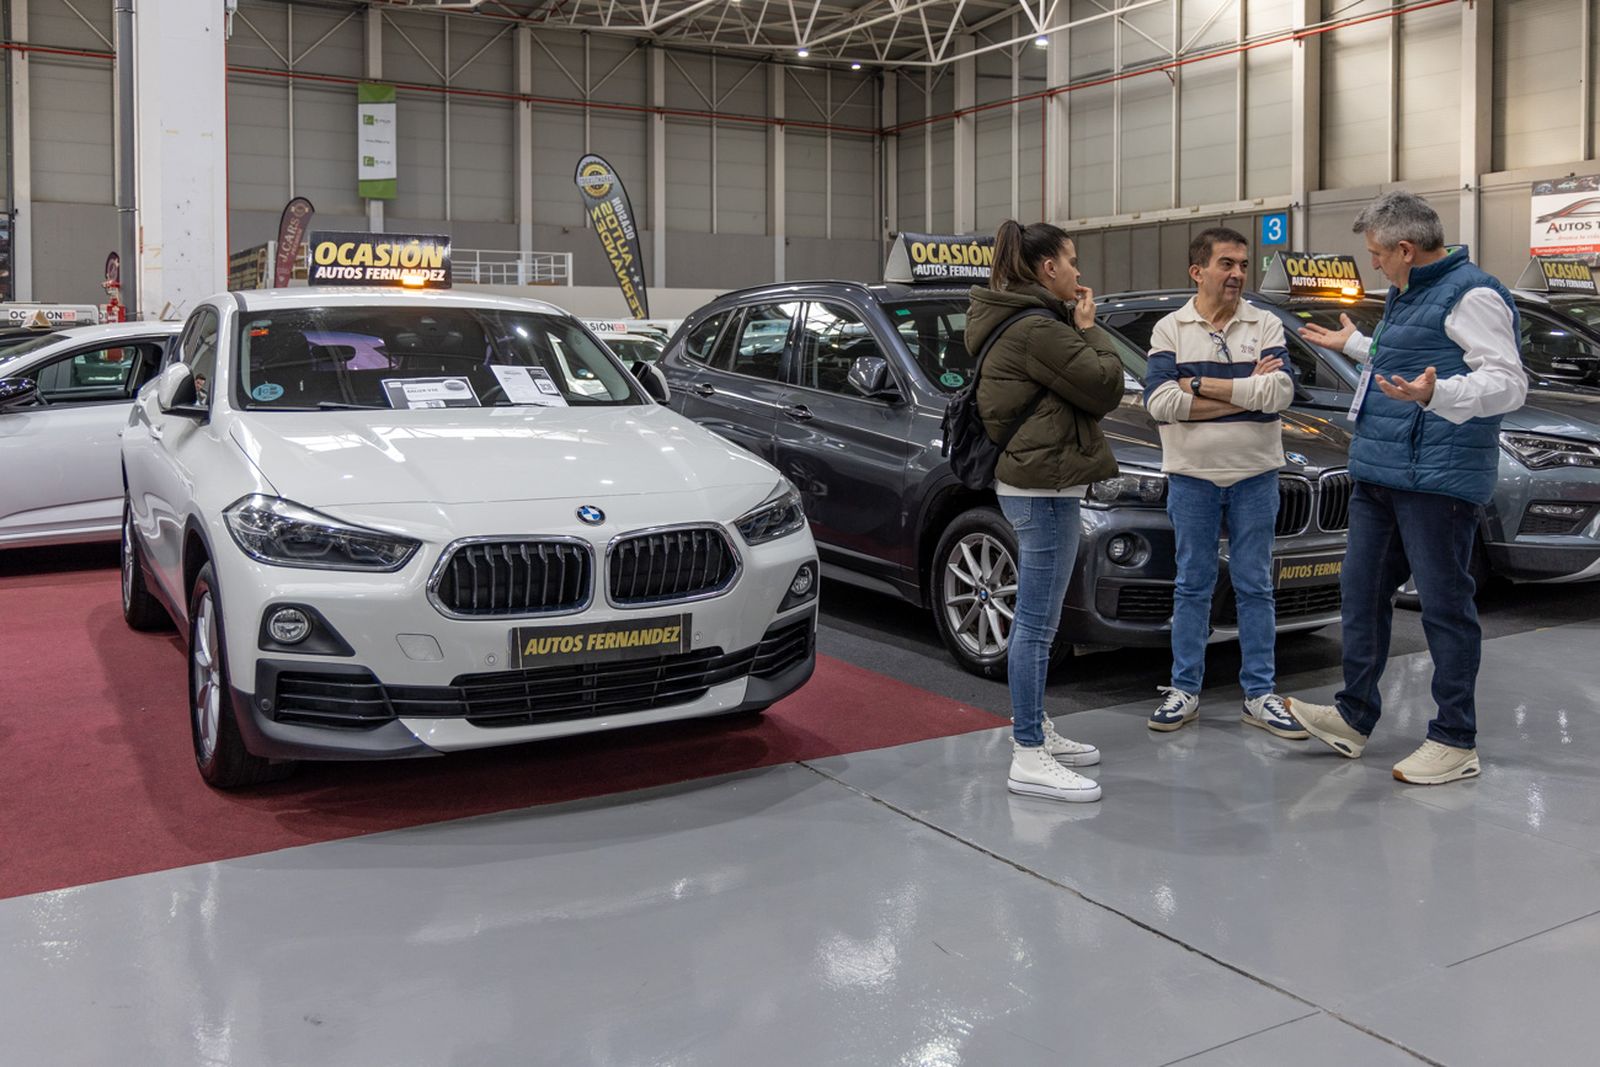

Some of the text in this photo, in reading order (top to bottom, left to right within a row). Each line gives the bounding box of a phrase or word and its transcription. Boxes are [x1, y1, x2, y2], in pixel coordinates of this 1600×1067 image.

[1268, 217, 1281, 241] 3
[1546, 221, 1592, 234] AUTOS
[315, 240, 443, 267] OCASIÓN
[911, 241, 995, 266] OCASIÓN
[315, 267, 446, 281] AUTOS FERNANDEZ
[916, 264, 991, 277] AUTOS FERNAND
[1286, 257, 1356, 278] OCASIÓN
[1543, 261, 1591, 280] OCASIÓN
[1292, 277, 1360, 288] AUTOS FERNANDEZ
[10, 309, 62, 320] OCÓN
[589, 320, 614, 331] SIÓN
[1280, 562, 1341, 579] AUTOS FERNA
[524, 626, 680, 656] AUTOS FERNANDEZ
